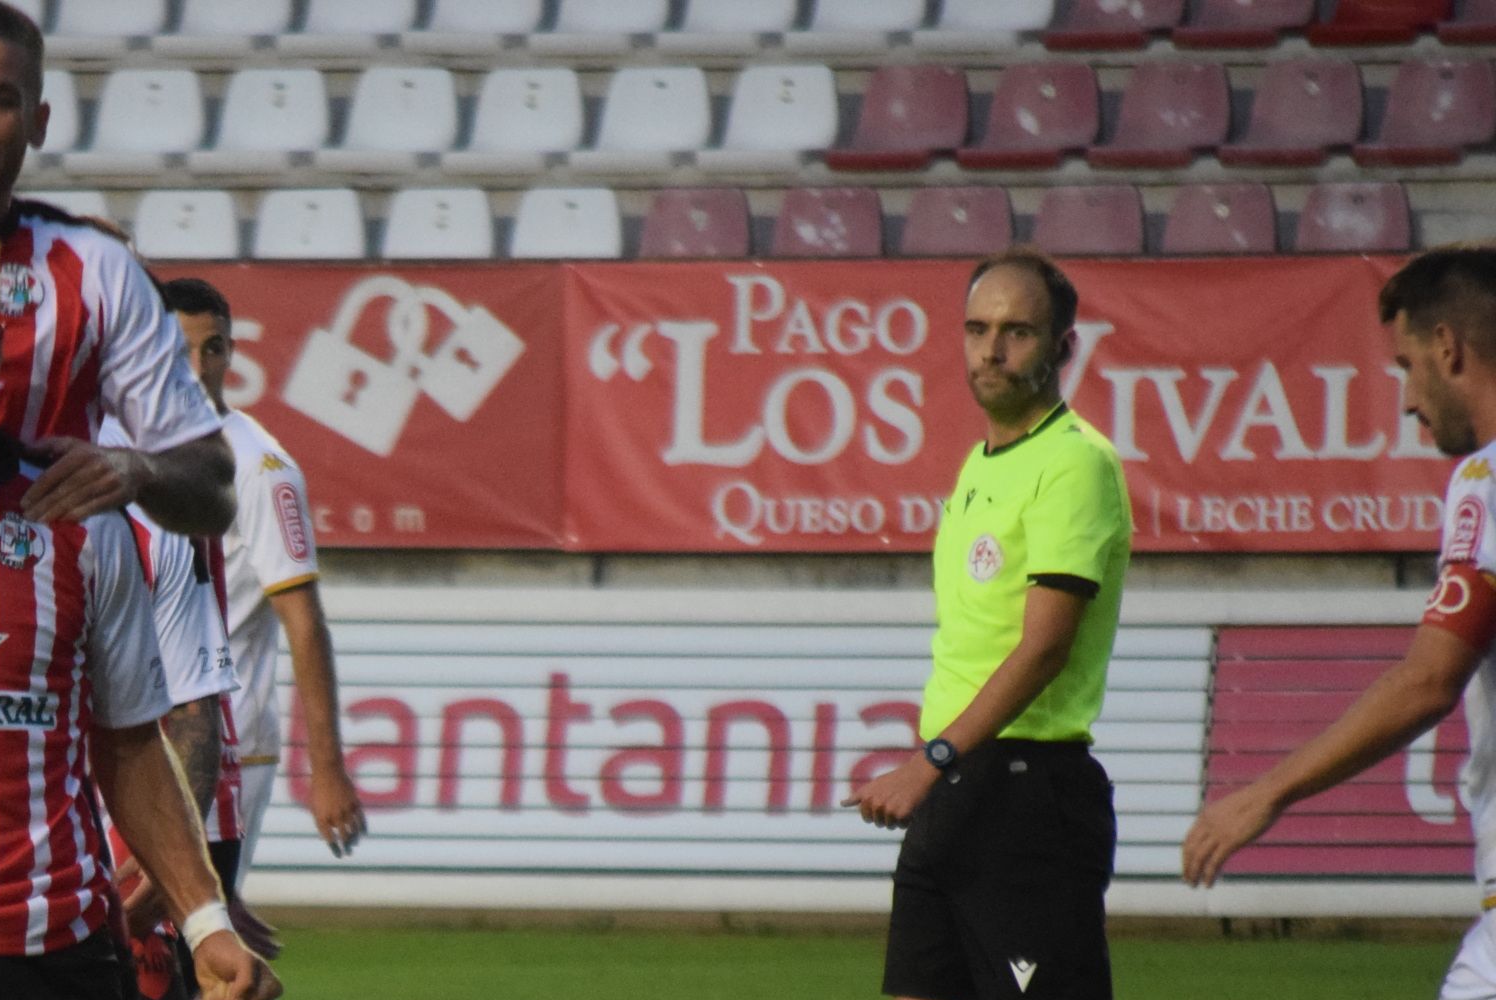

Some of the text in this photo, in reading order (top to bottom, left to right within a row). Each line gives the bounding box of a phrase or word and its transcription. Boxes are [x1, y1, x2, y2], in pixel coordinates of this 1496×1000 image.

[726, 273, 928, 356] PAGO
[712, 480, 886, 546] QUESO
[1177, 496, 1312, 534] LECHE
[1322, 494, 1446, 534] CRUD
